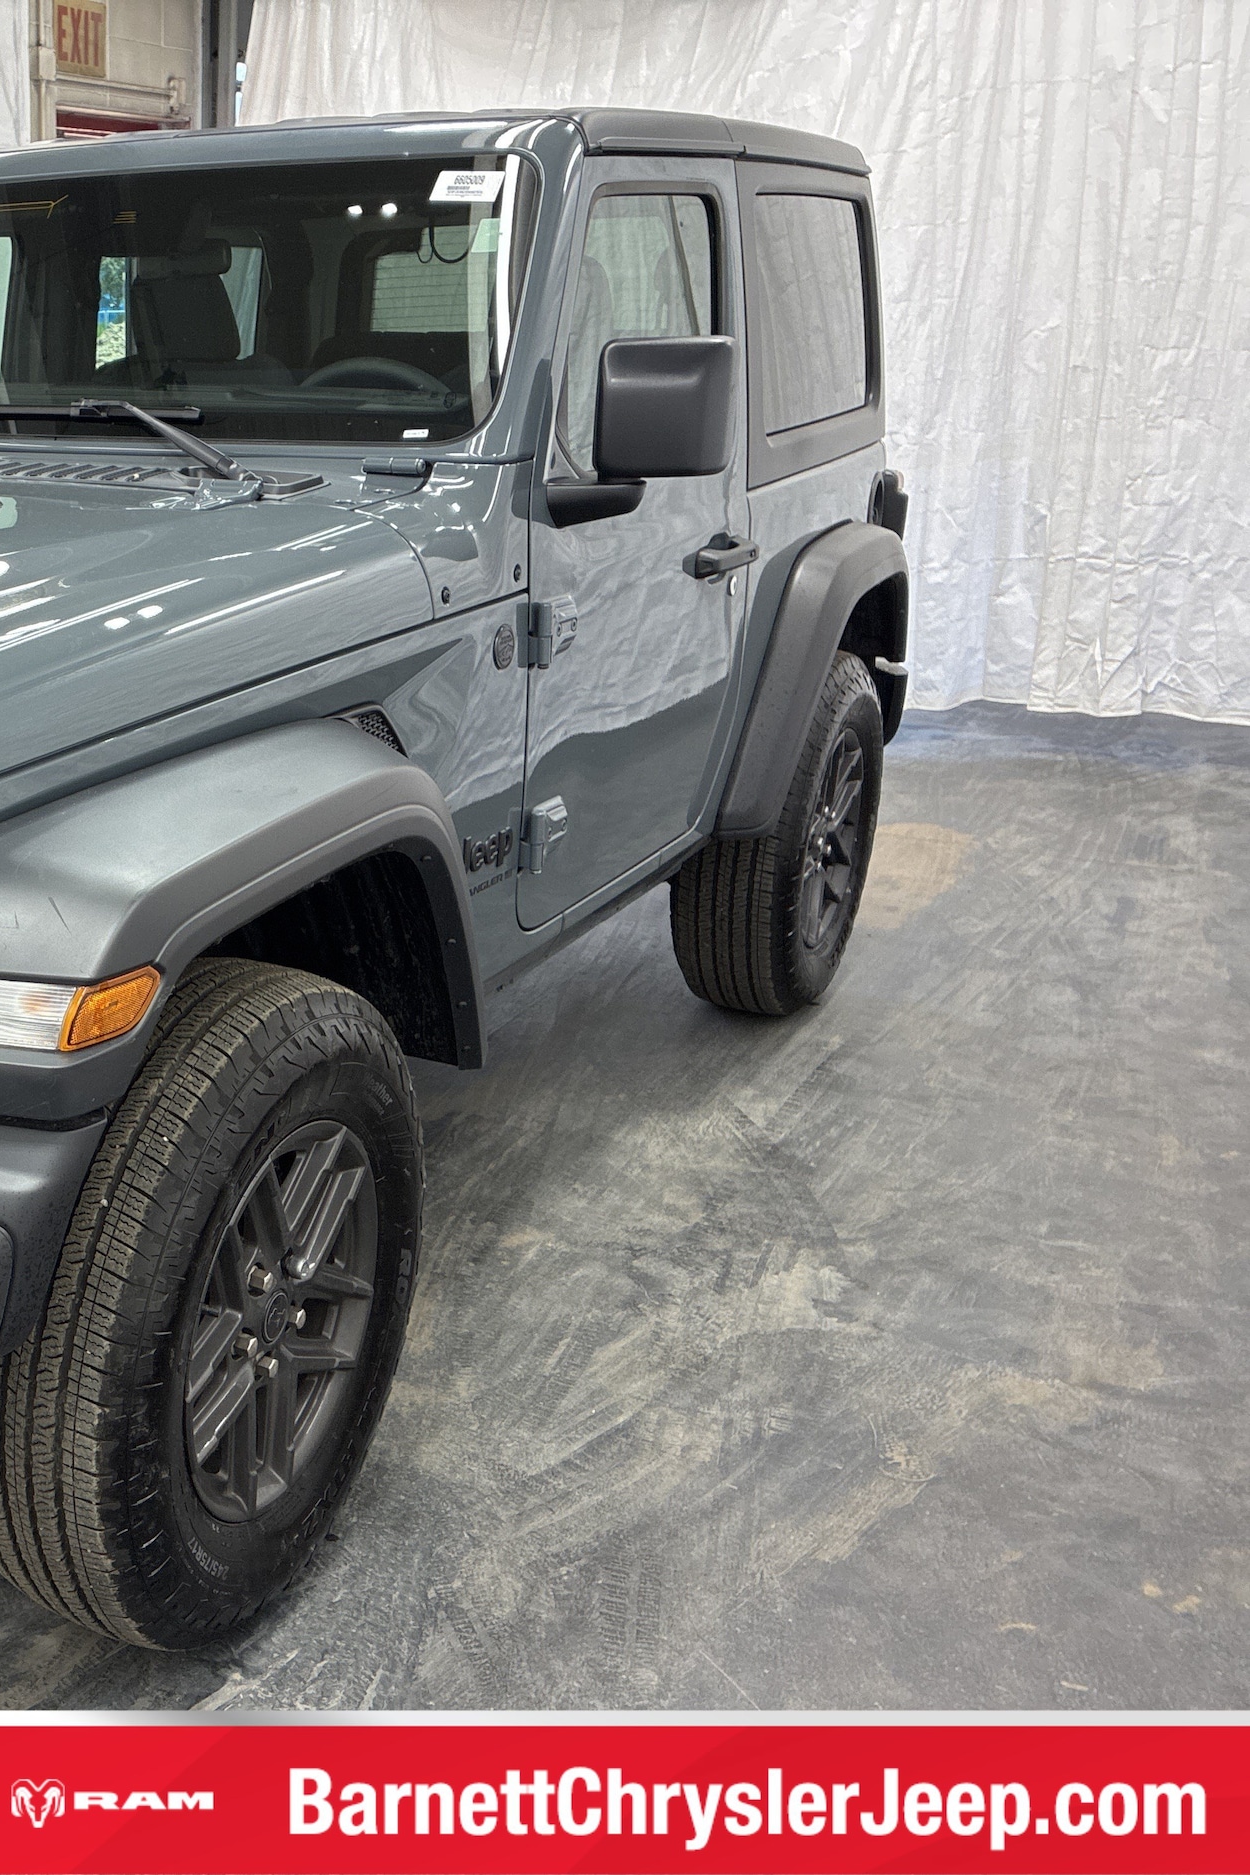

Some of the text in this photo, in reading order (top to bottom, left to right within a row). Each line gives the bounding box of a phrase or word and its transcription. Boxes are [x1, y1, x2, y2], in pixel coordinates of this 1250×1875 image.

[56, 5, 104, 67] EXIT
[463, 826, 514, 874] Jeep
[186, 1536, 230, 1581] 245/75R17
